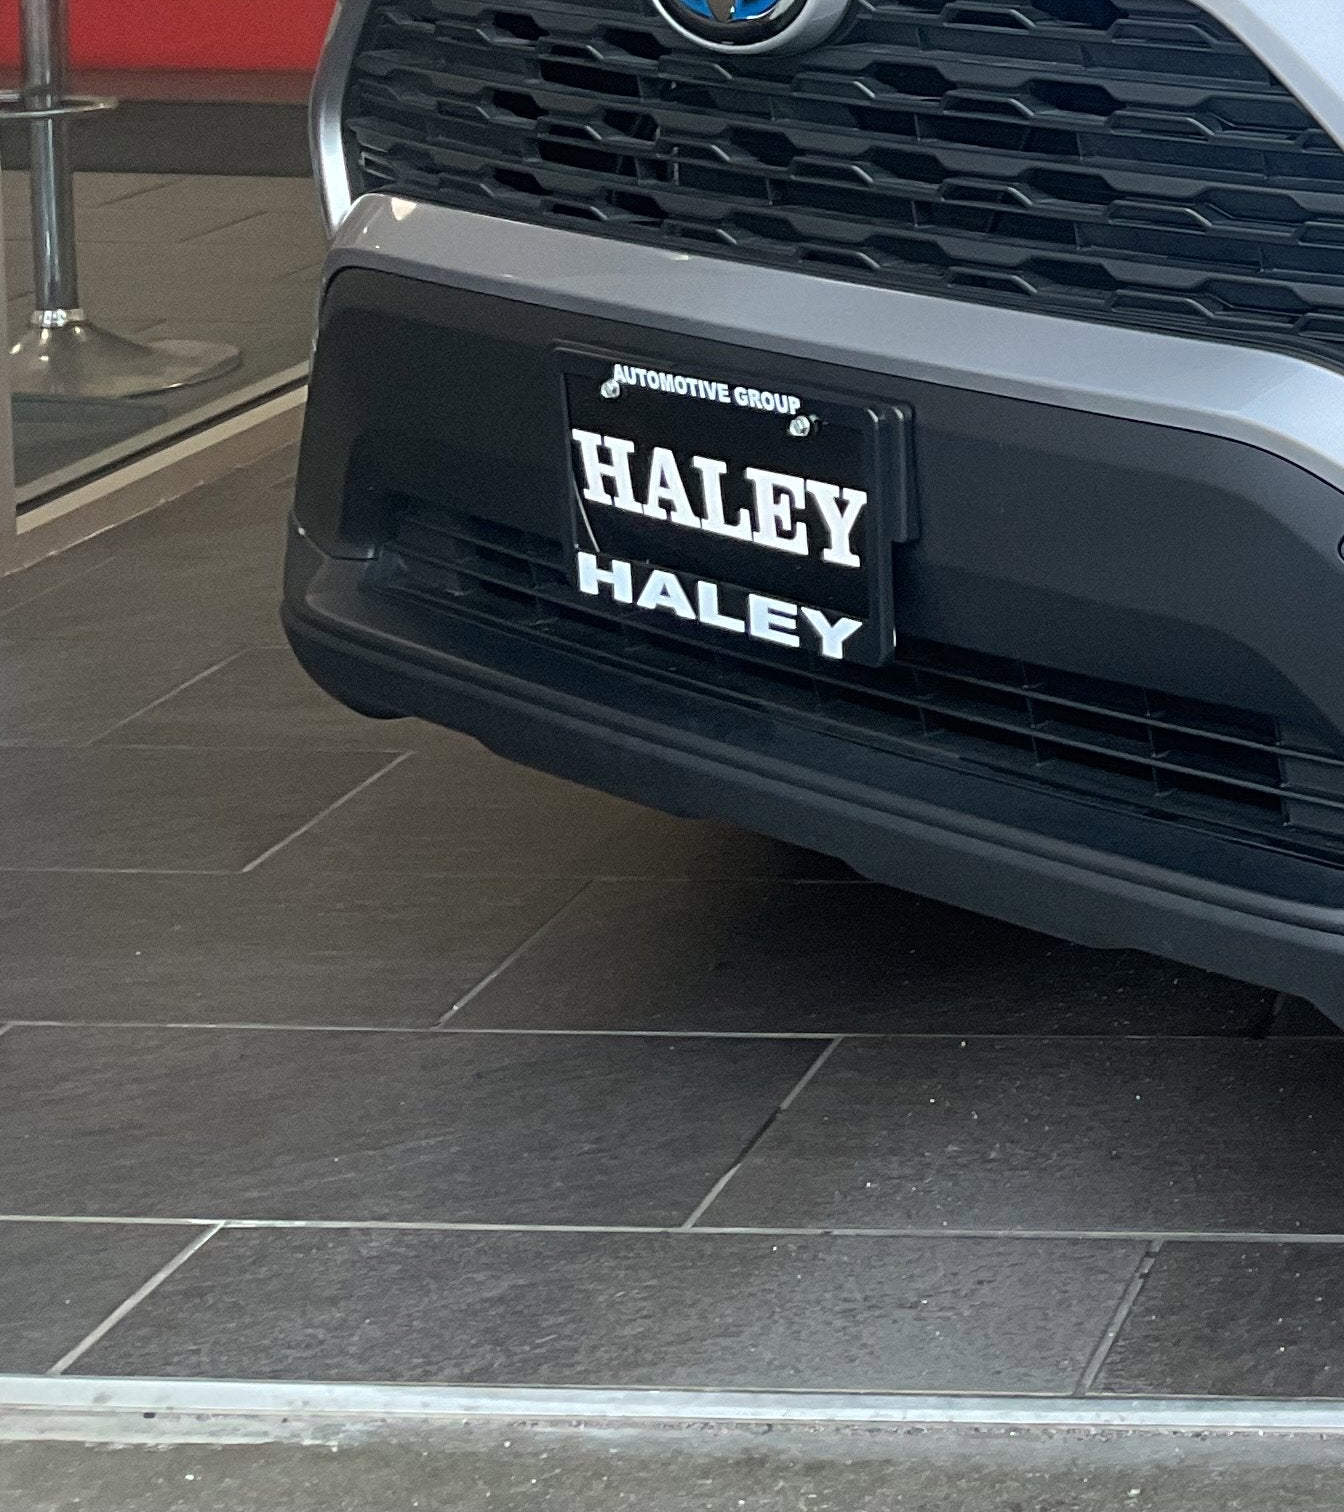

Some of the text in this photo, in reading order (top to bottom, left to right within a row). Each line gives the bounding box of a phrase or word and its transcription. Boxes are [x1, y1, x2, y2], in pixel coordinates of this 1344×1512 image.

[612, 363, 802, 416] AUTOMOTIVE GROUP
[571, 428, 868, 568] HALEY
[577, 550, 863, 660] HALEY
